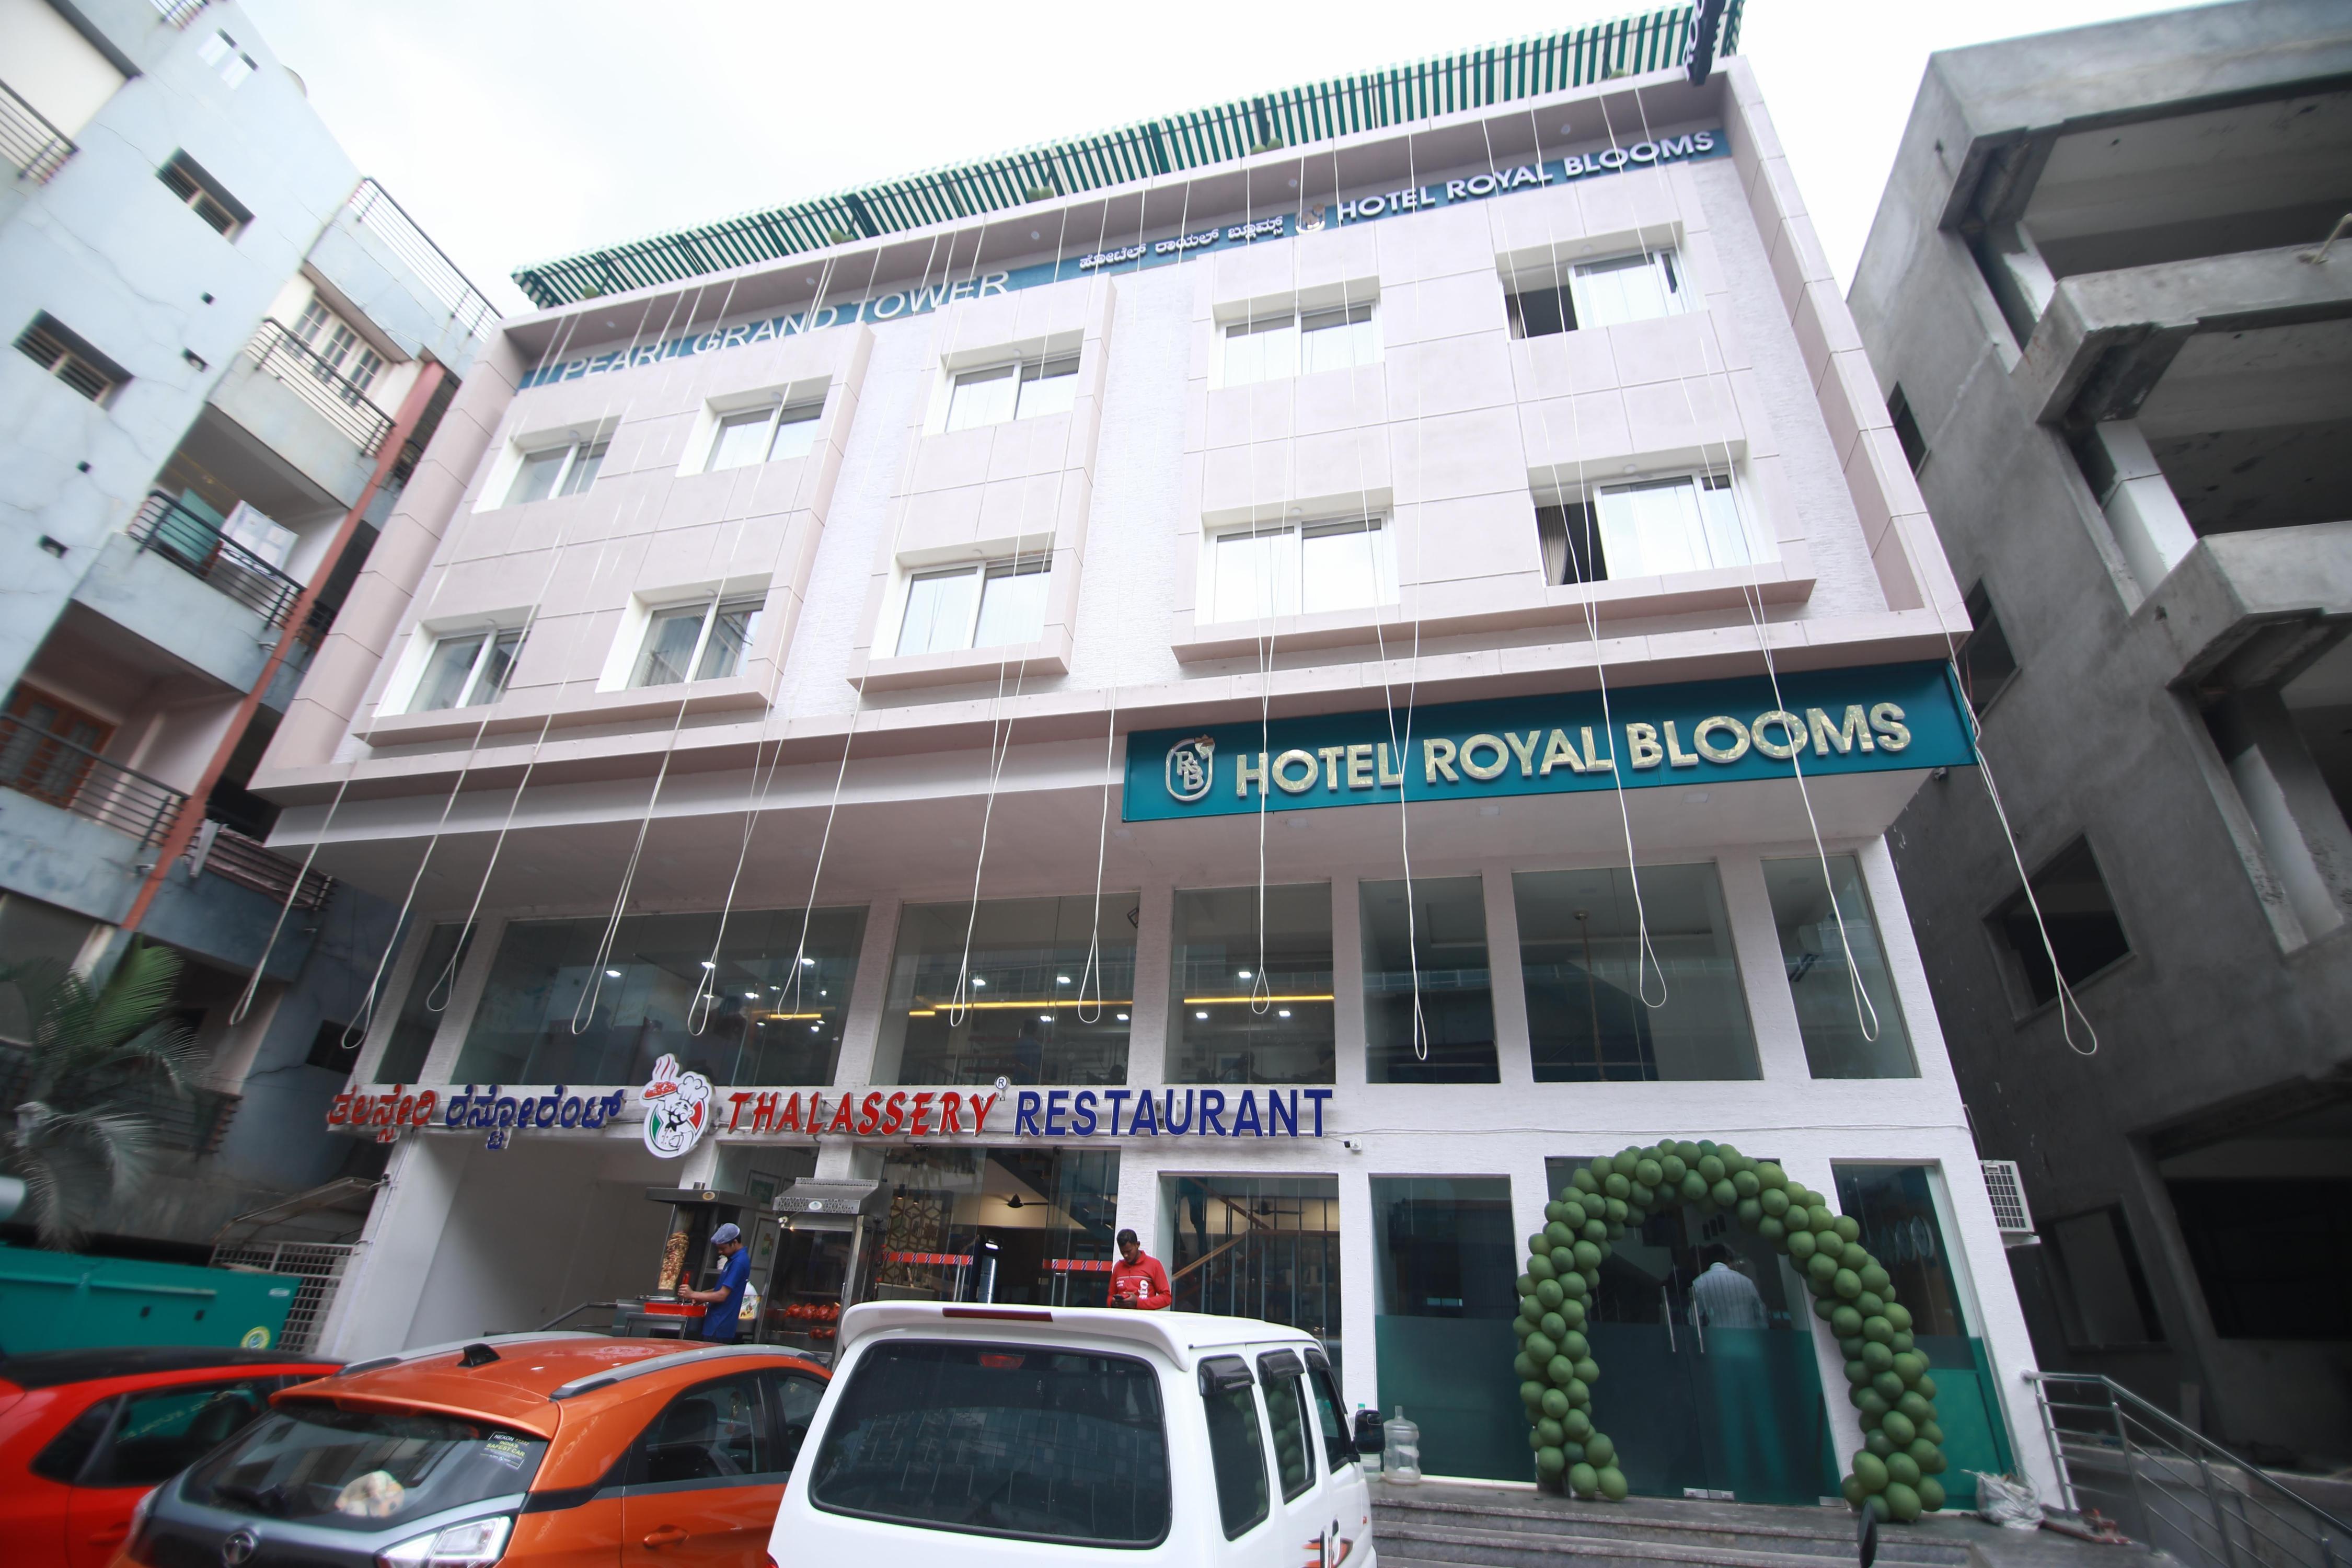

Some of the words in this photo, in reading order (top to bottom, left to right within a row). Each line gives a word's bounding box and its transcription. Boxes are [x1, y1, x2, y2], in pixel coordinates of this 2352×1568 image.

[1338, 186, 1436, 220] HOTEL
[1446, 163, 1553, 200] ROYAL
[1563, 131, 1714, 177] BLOOMS
[1155, 228, 1219, 253] ರಾಯಲ್
[558, 339, 679, 383] PEARL
[692, 305, 838, 355] GRAND
[851, 270, 1009, 323] TOWER
[1236, 743, 1404, 797] HOTEL
[1423, 726, 1613, 783] ROYAL
[1625, 702, 1911, 769] BLOOMS
[728, 1091, 999, 1137] THALASSERY
[1013, 1088, 1333, 1138] RESTAURANT
[486, 1443, 512, 1451] SAFEST
[511, 1448, 525, 1457] CAR
